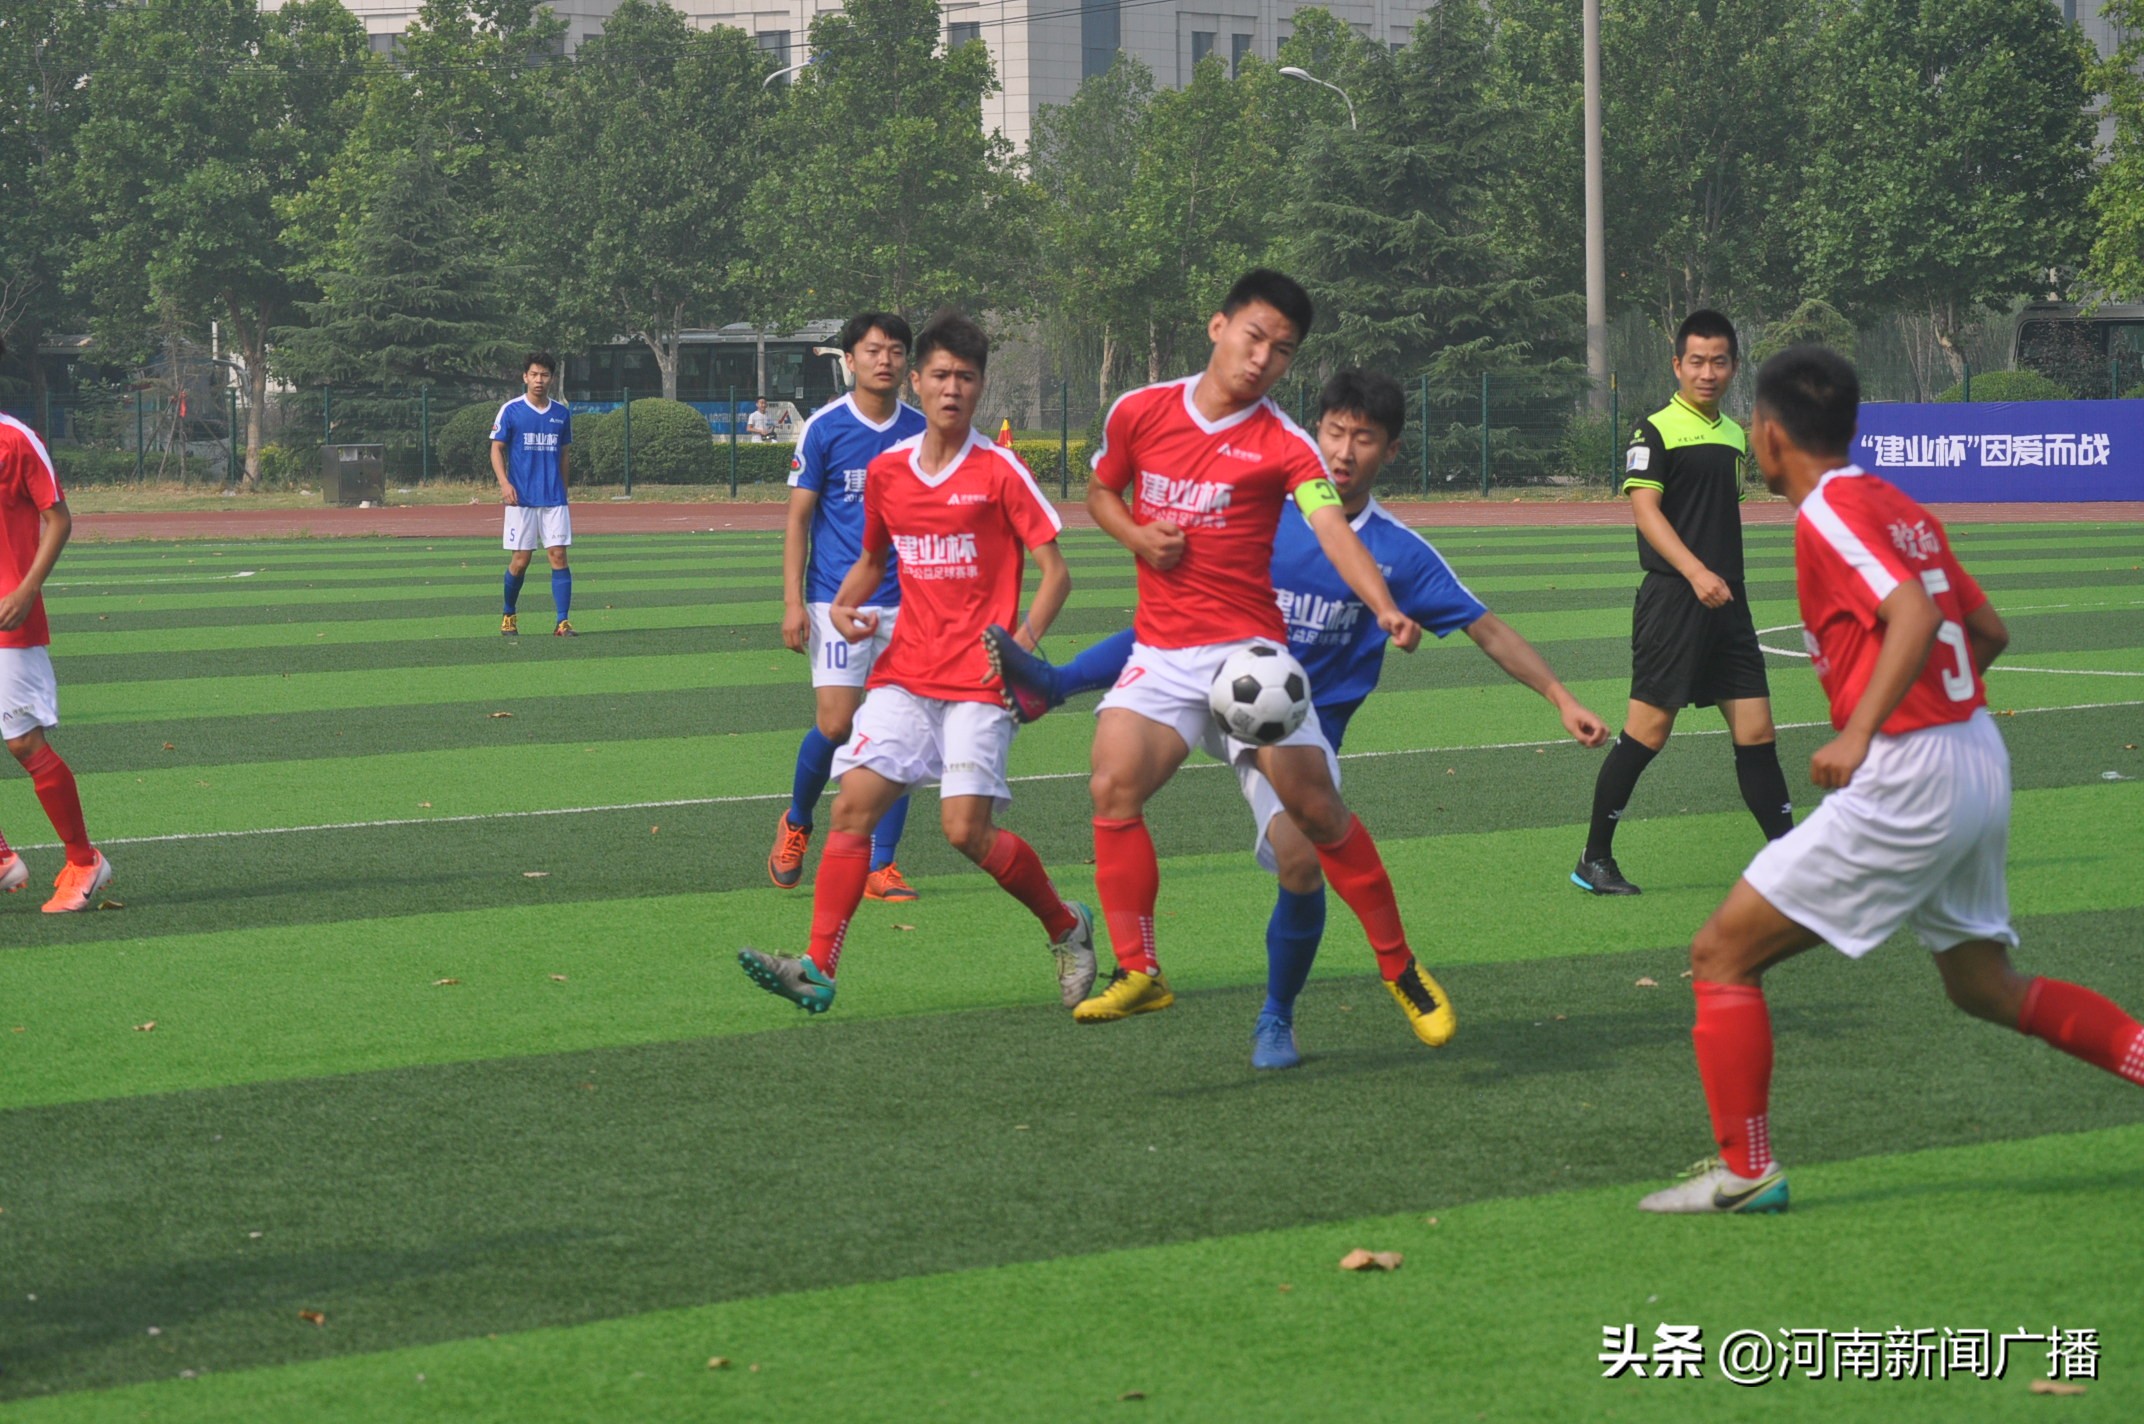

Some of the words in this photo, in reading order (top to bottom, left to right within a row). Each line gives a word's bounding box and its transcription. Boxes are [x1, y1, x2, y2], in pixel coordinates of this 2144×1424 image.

[1861, 433, 2111, 467] “建业杯”因爱而战
[1140, 470, 1234, 515] 建业杯
[892, 533, 977, 566] 建业杯
[1272, 587, 1364, 631] 建业杯
[826, 641, 848, 669] 10
[853, 732, 870, 756] 7
